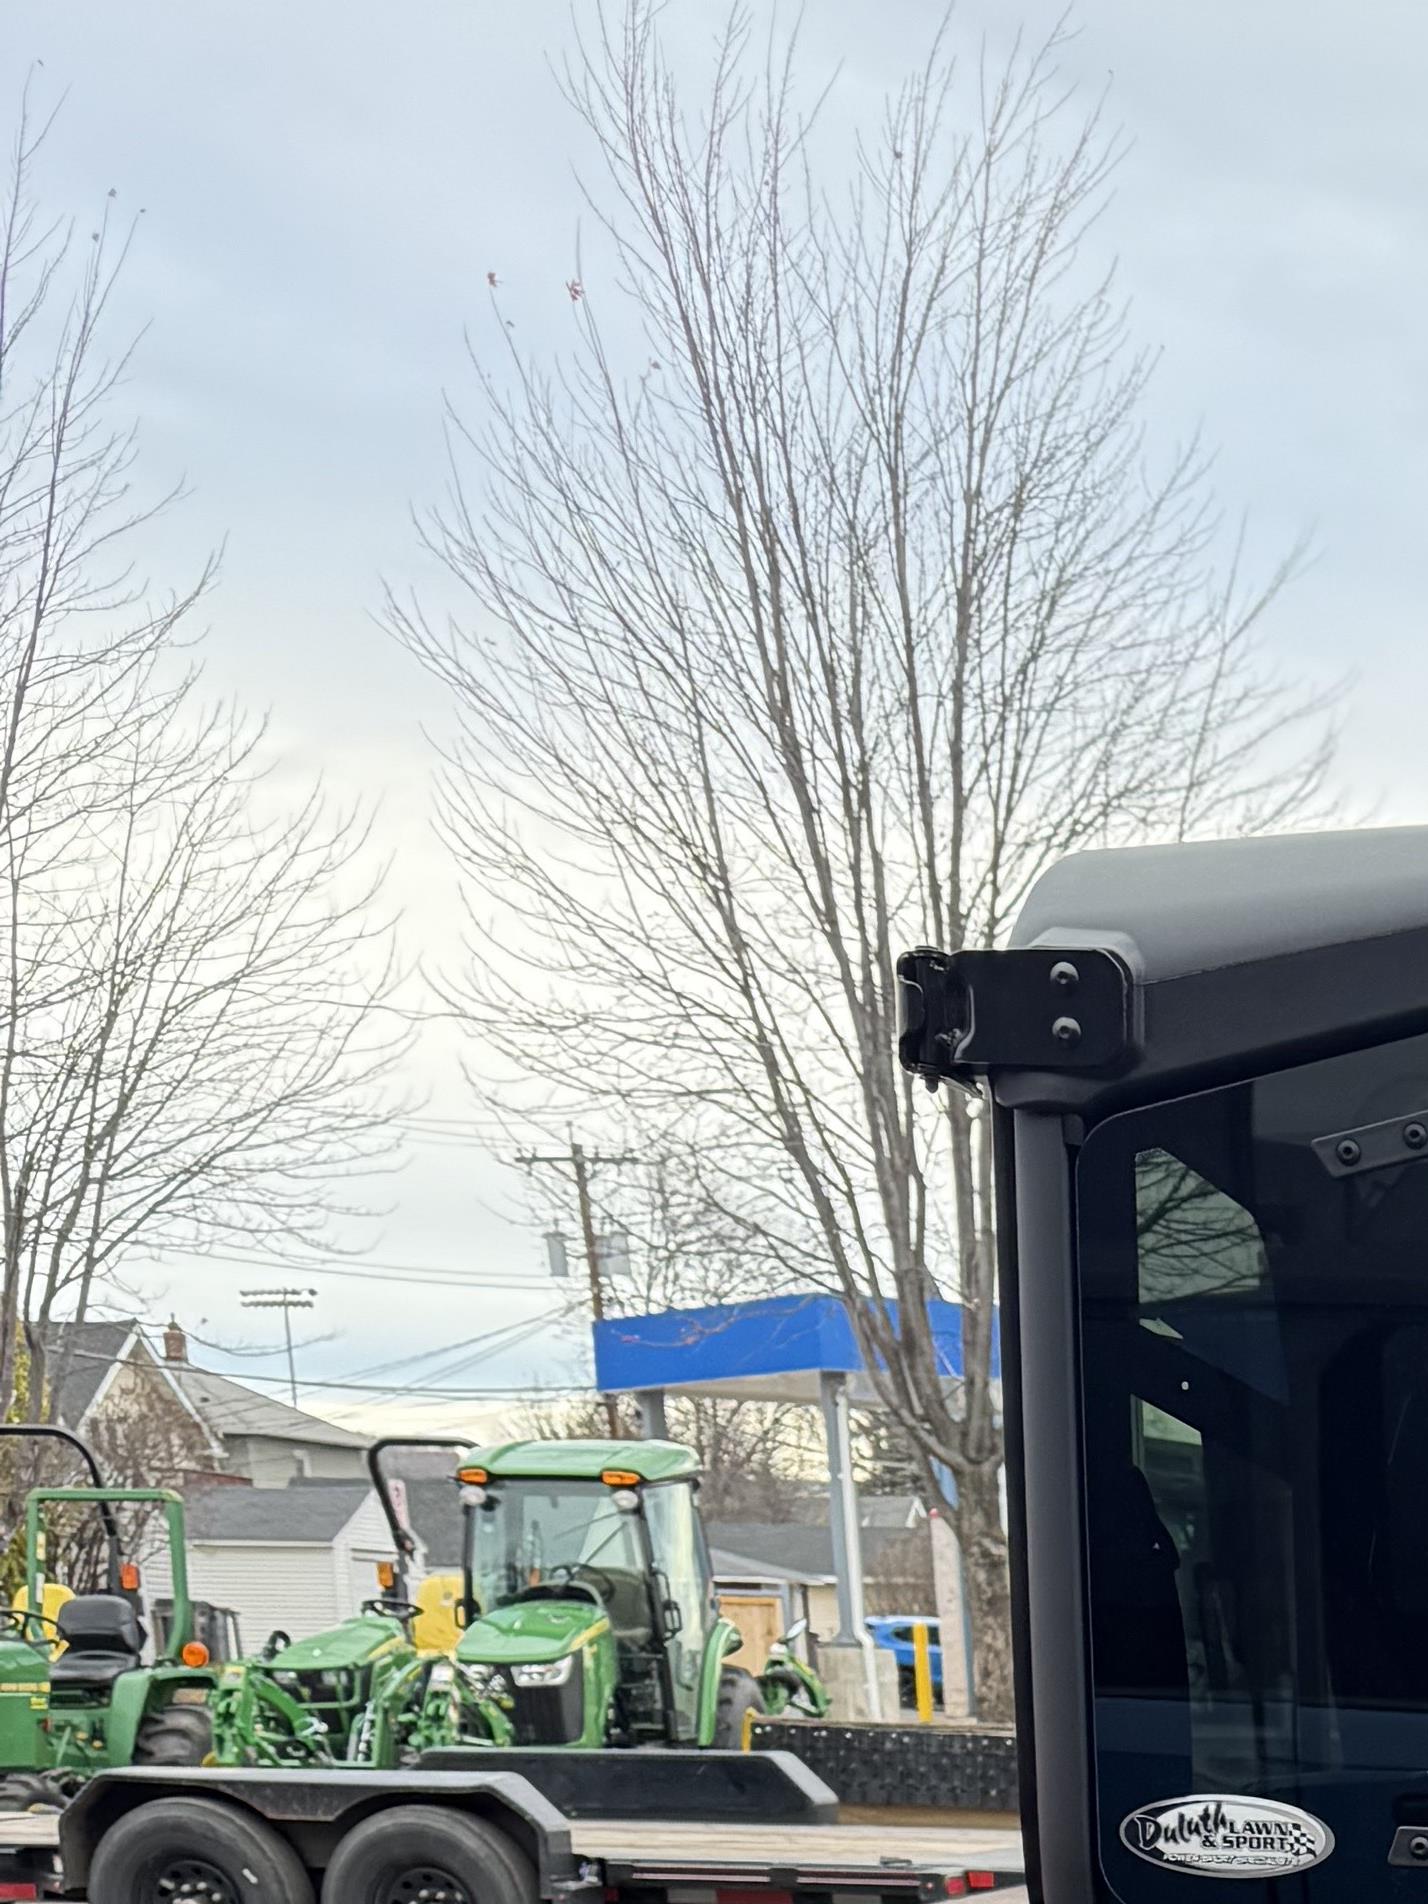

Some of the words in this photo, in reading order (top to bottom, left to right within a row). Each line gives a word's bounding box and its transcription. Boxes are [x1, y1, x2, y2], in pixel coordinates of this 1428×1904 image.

[1134, 1802, 1228, 1850] Duluth
[1229, 1820, 1289, 1835] LAWN
[1202, 1835, 1217, 1849] &
[1223, 1835, 1290, 1851] SPORT
